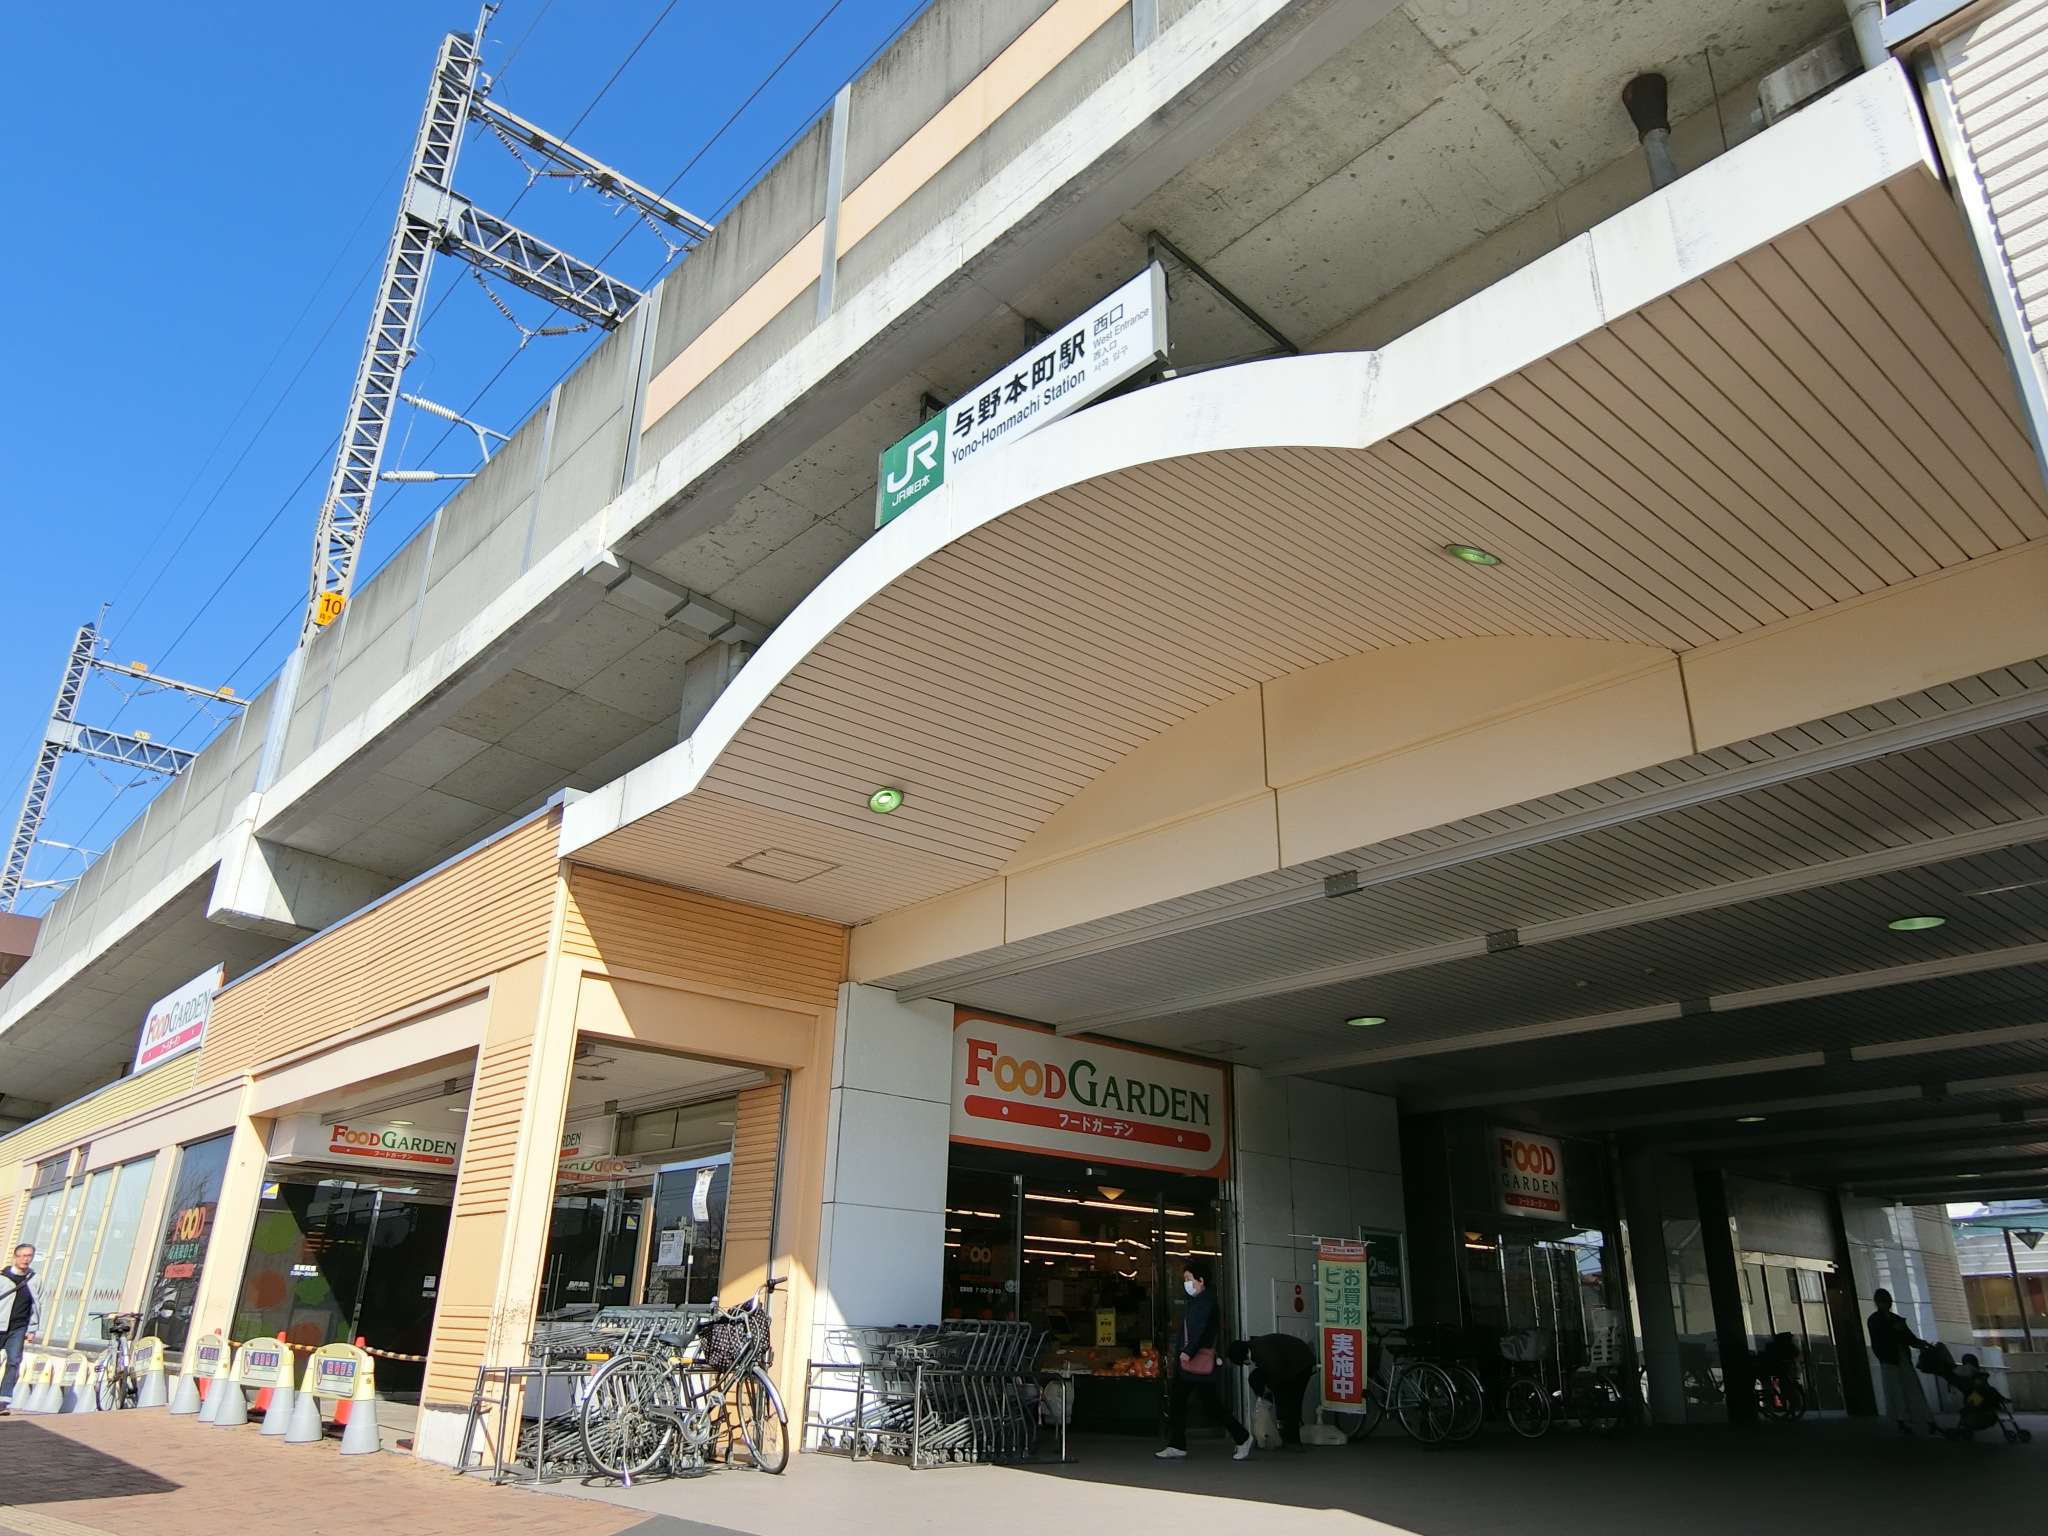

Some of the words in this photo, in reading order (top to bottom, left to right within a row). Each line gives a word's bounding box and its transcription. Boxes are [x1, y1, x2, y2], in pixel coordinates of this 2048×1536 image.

[1093, 303, 1124, 336] 西口
[1093, 331, 1113, 349] West
[1114, 308, 1149, 336] Entrance
[952, 329, 1086, 437] 与野本町駅
[952, 395, 1041, 465] Yono-Hommachi
[1043, 369, 1086, 407] Station
[886, 429, 939, 494] JR
[891, 474, 931, 508] JR東日本
[324, 598, 342, 615] 10
[1058, 1112, 1134, 1138] フードガーデン
[1499, 1137, 1556, 1176] FOOD
[1502, 1173, 1559, 1195] GARDEN
[172, 1206, 207, 1242] FOOD
[168, 1243, 200, 1260] GARDEN
[1325, 1266, 1342, 1325] ビンゴ
[1343, 1268, 1361, 1326] お買物
[1331, 1333, 1355, 1400] 実施中
